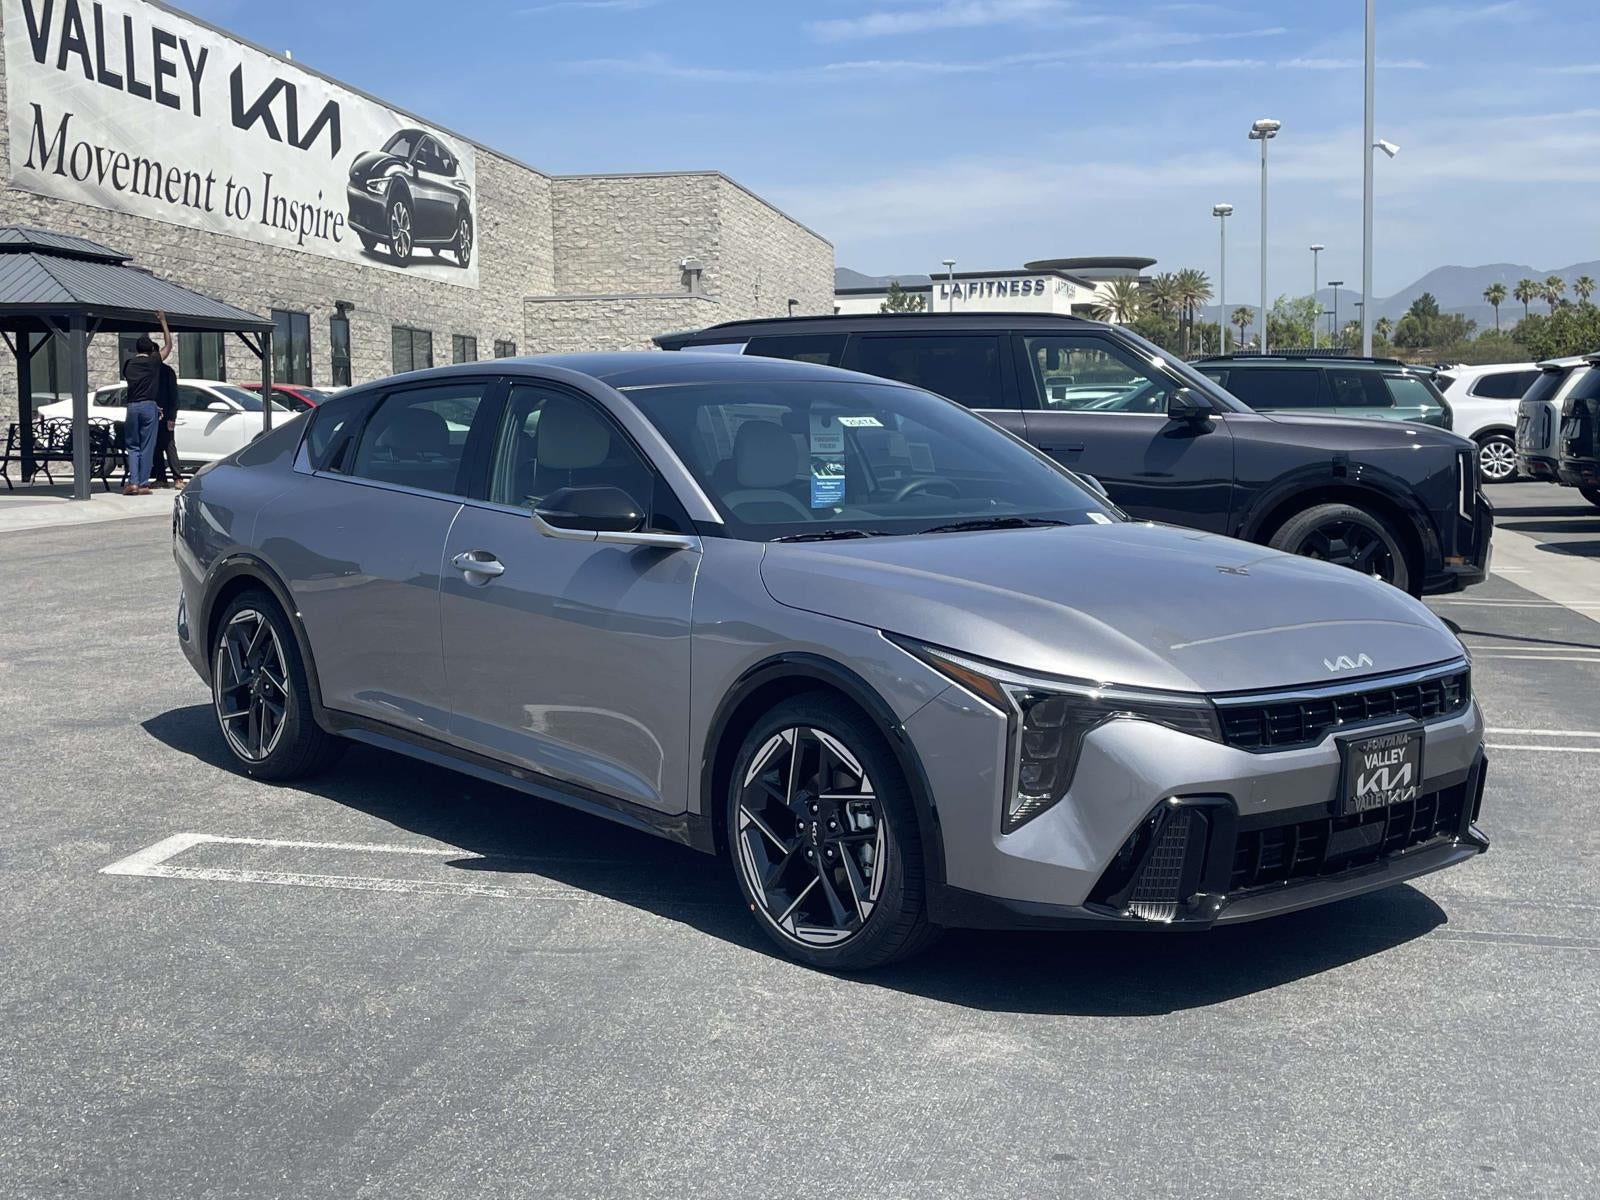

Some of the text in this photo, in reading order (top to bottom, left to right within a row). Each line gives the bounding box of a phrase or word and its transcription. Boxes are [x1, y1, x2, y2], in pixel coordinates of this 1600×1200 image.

[22, 0, 342, 161] VALLEY KIA
[23, 102, 346, 246] Movement to Inspire
[968, 279, 1045, 296] FITNESS
[1323, 653, 1373, 672] KIA
[1366, 734, 1409, 751] FONTANA
[1364, 747, 1406, 769] VALLEY
[1356, 763, 1412, 796] KIA
[1353, 791, 1387, 812] VALLEY
